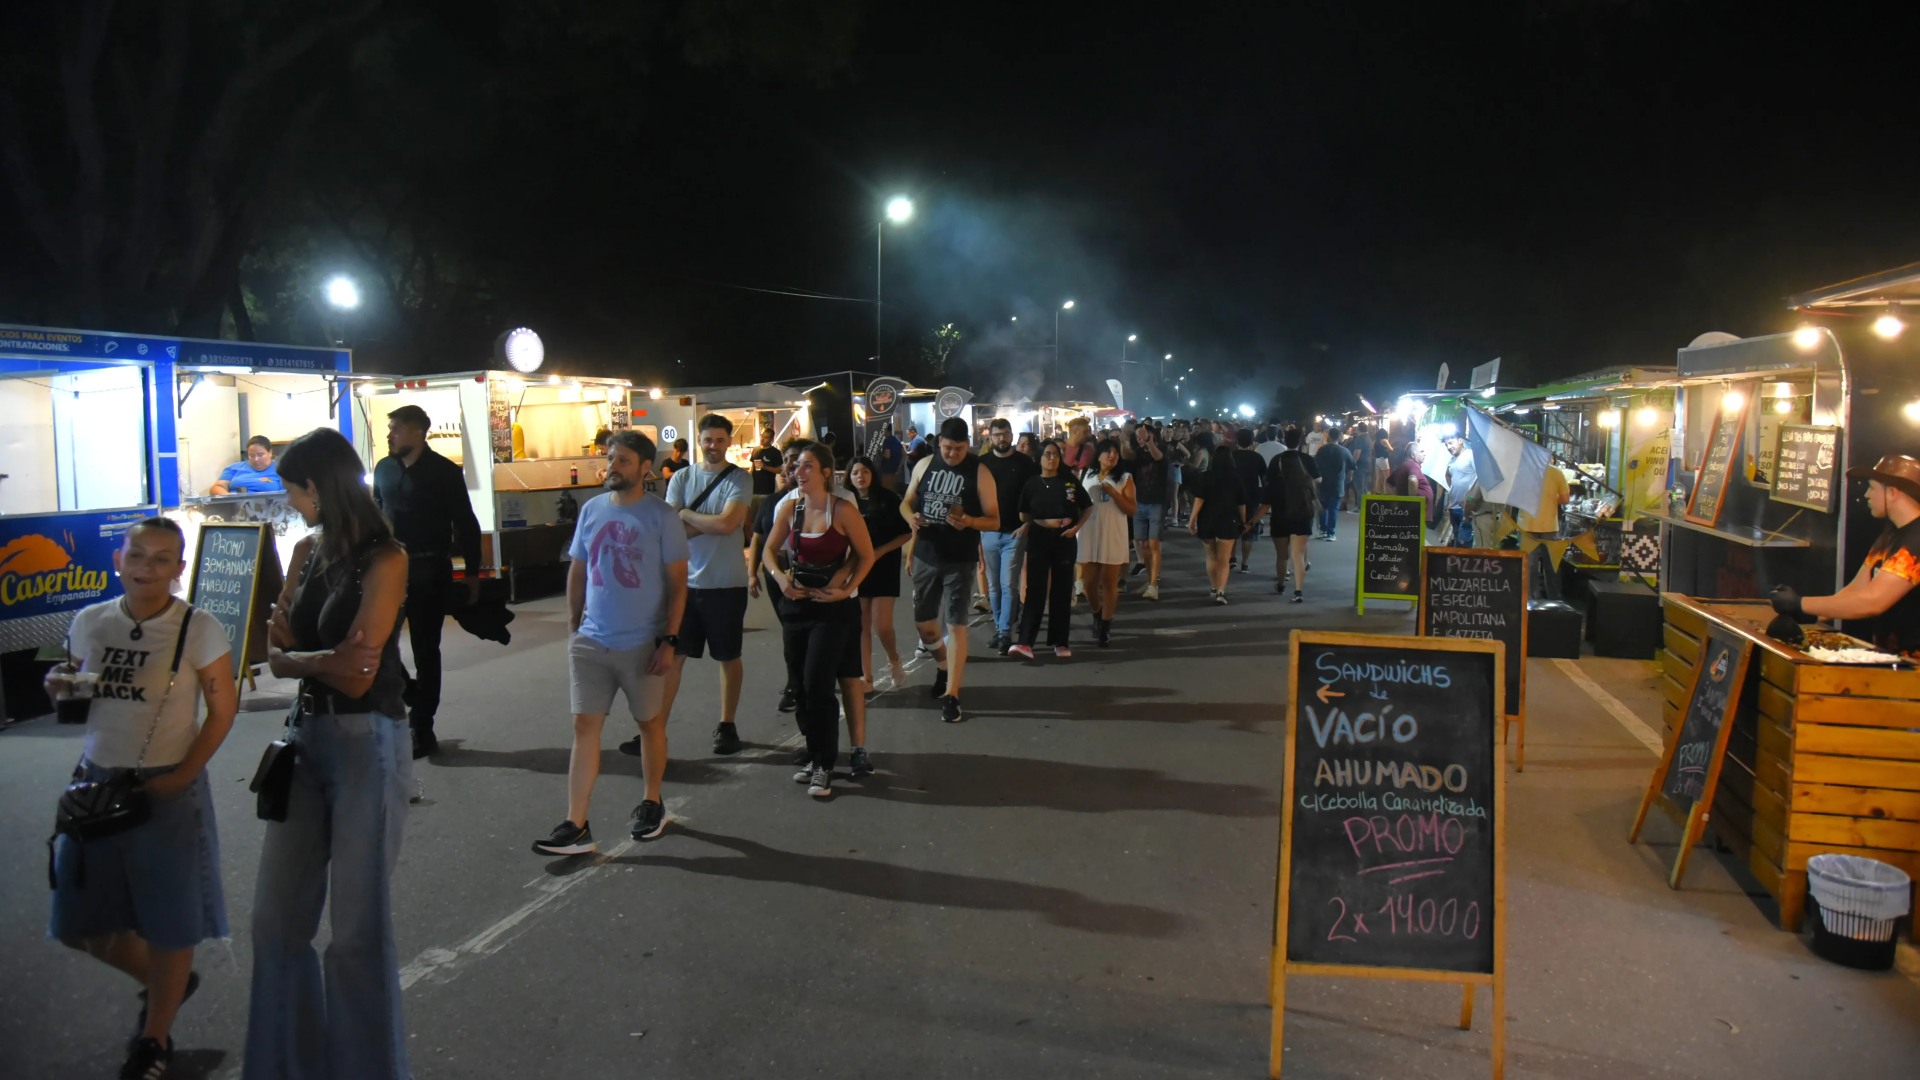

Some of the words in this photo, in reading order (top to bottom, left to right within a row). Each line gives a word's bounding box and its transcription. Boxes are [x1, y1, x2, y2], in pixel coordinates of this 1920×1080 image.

[22, 331, 45, 341] PARA
[47, 333, 82, 344] EVENTOS
[664, 429, 676, 440] 80
[1649, 446, 1668, 455] ACE
[1645, 456, 1665, 465] VINO
[928, 469, 964, 496] TODO
[211, 531, 246, 558] PROMO
[1446, 556, 1503, 575] PIZZAS
[1, 563, 108, 607] Caseritas
[1430, 577, 1511, 592] MUZZARELLA
[46, 589, 101, 606] Empanadas
[1432, 610, 1506, 627] NAPOLITANA
[101, 647, 150, 667] TEXT
[101, 666, 136, 684] ME
[1305, 704, 1418, 748] VACÍO
[1313, 758, 1468, 792] AHUMADO
[1343, 812, 1465, 858] PROMO
[1379, 894, 1481, 939] 14.000
